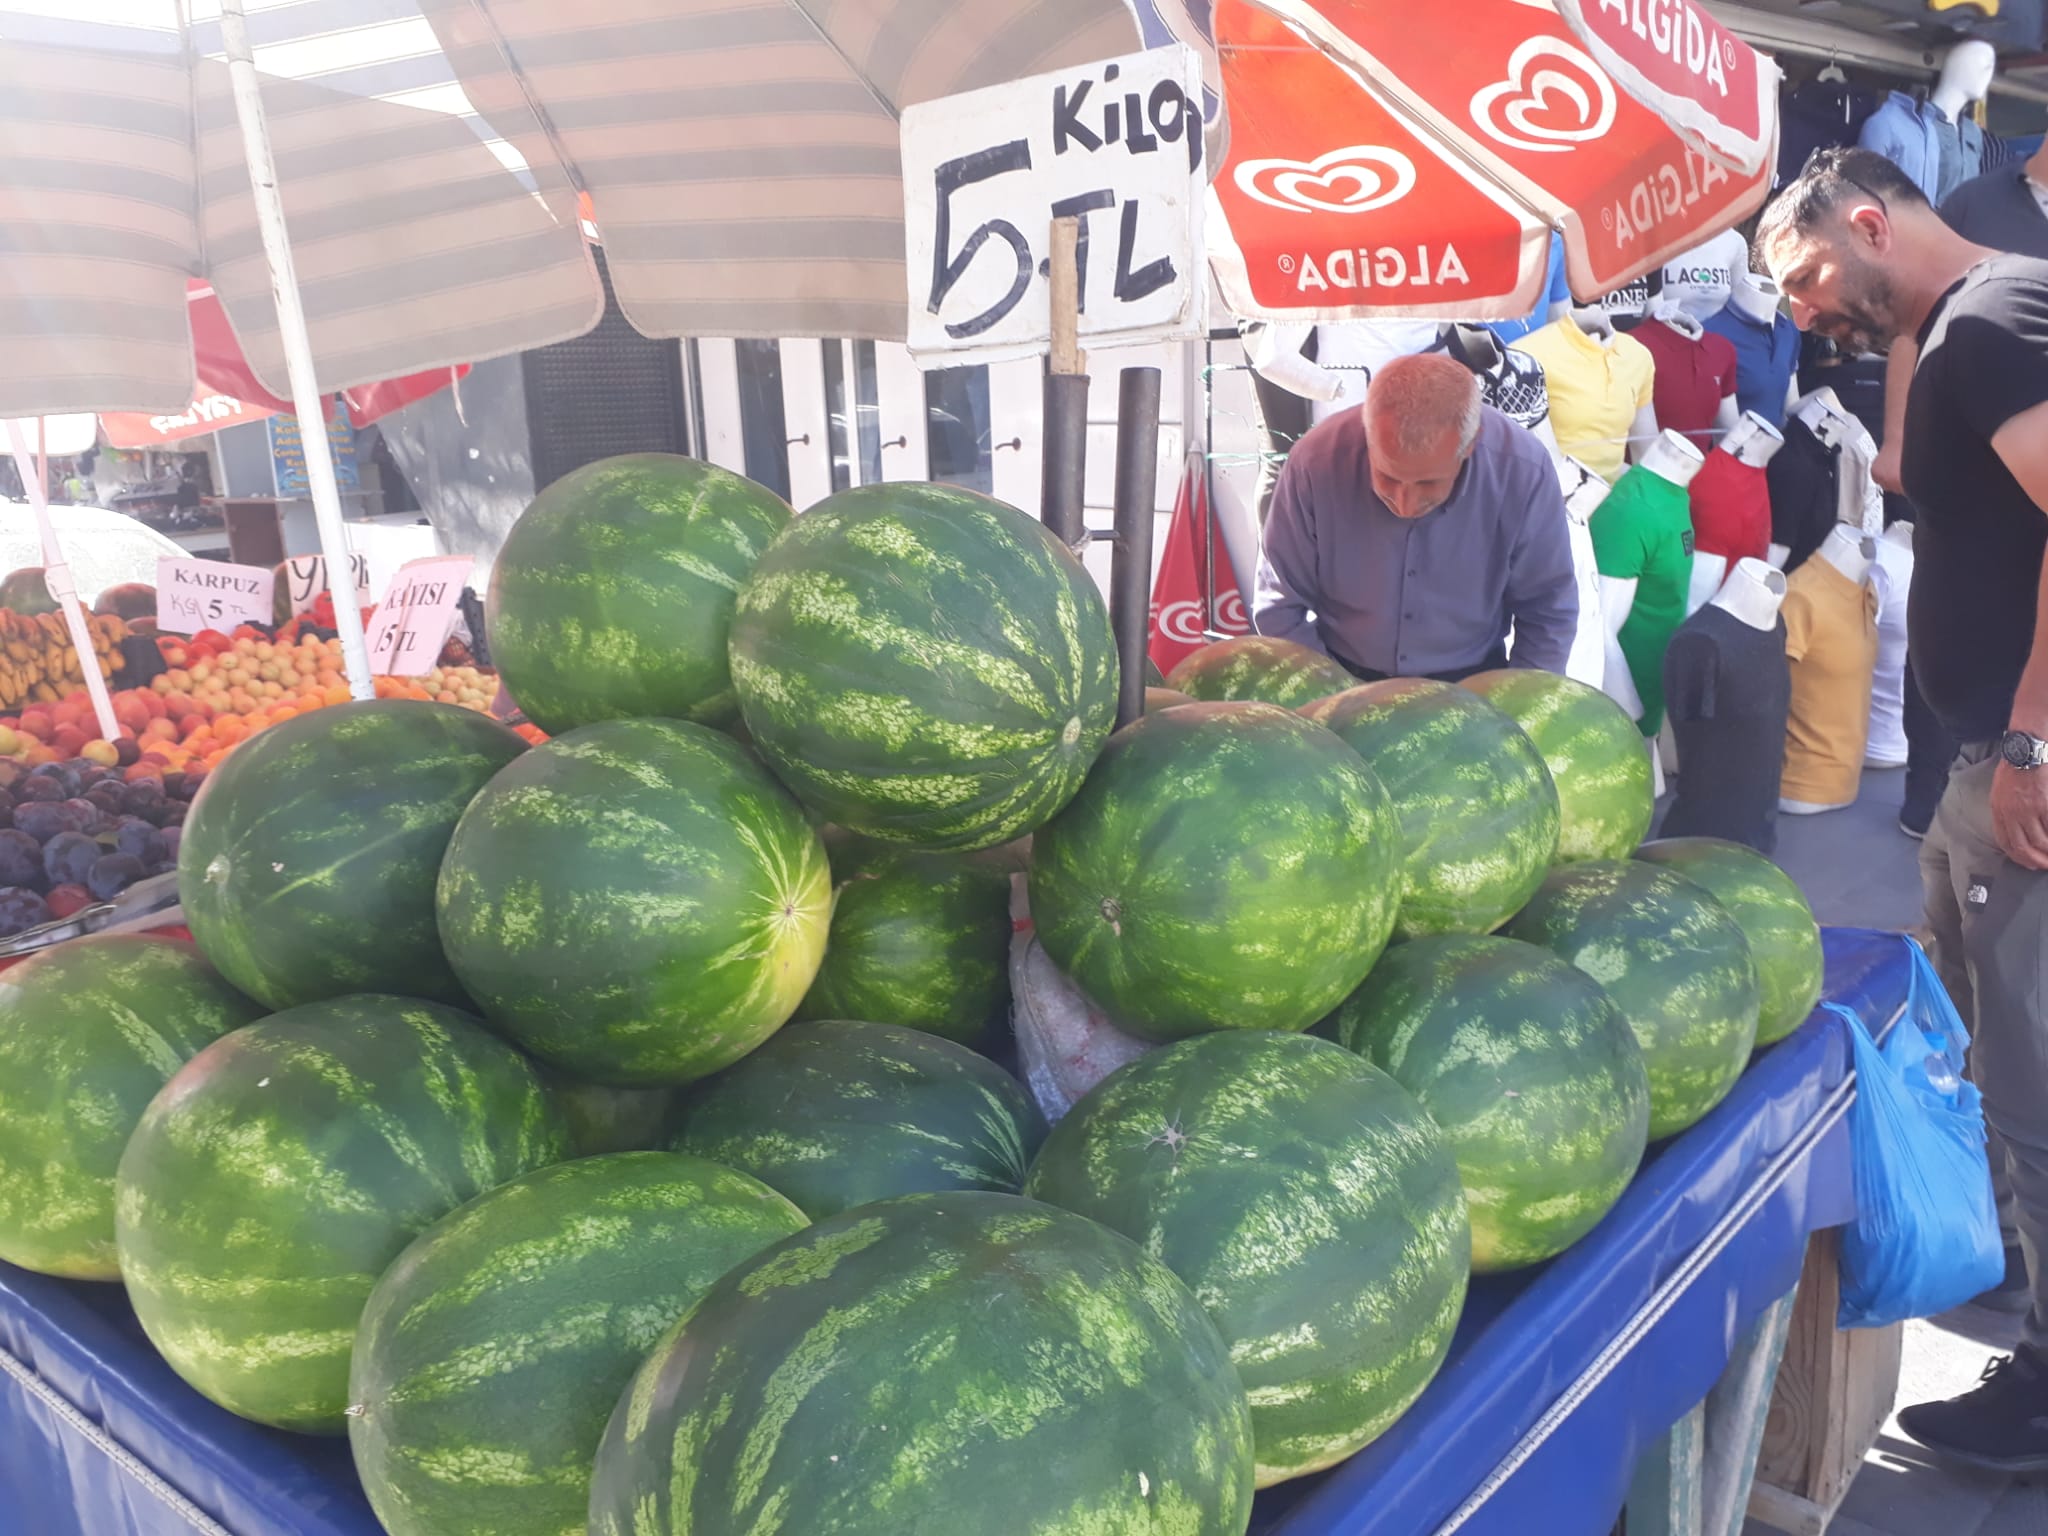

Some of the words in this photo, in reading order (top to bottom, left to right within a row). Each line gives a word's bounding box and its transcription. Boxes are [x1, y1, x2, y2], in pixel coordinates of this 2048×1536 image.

[1664, 267, 1731, 285] LACOSTE
[174, 567, 261, 596] KARPUZ
[208, 599, 223, 620] 5
